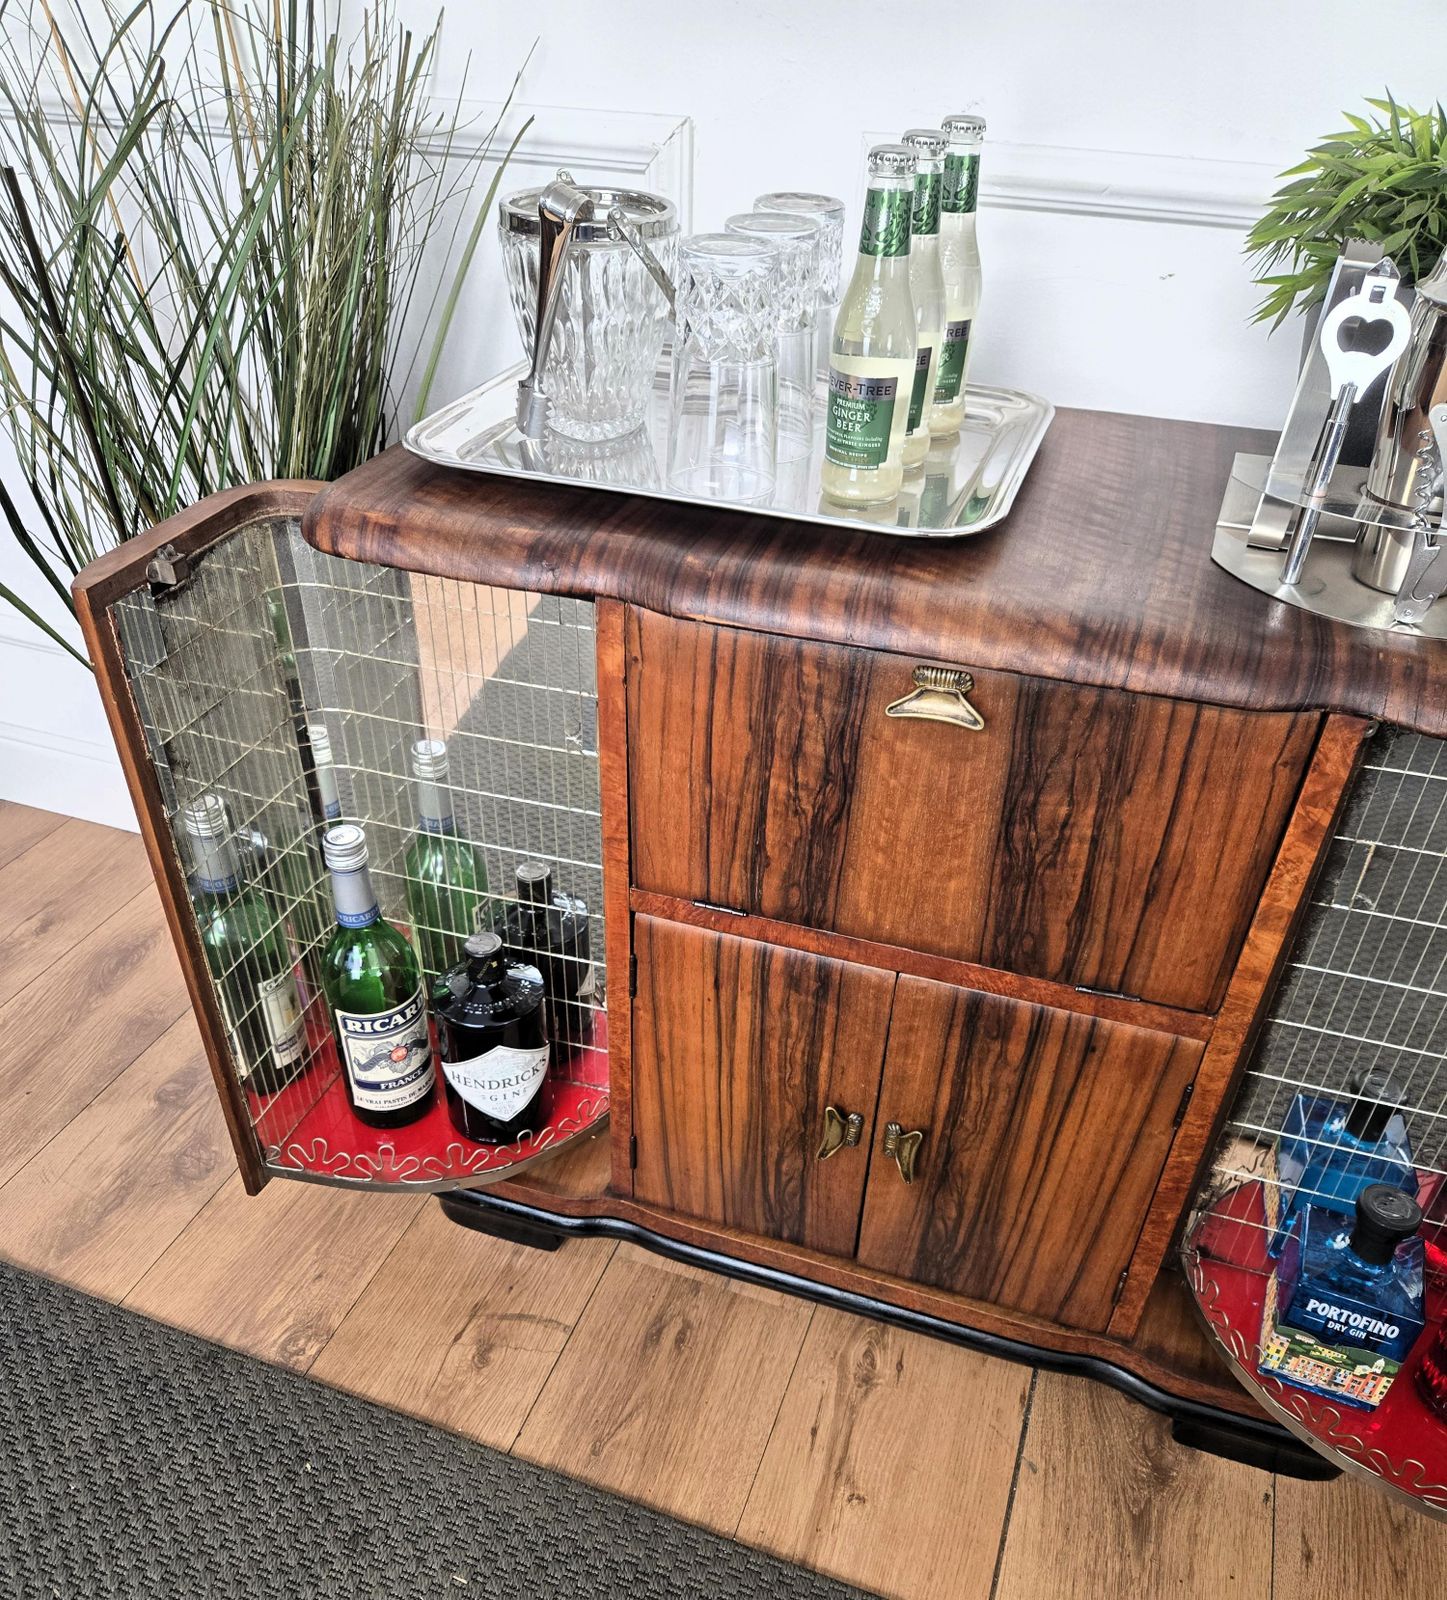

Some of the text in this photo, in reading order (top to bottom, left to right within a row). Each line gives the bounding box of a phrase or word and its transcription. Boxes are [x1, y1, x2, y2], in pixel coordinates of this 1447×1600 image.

[829, 376, 892, 396] EVER-TREE
[832, 405, 871, 422] GINGER
[836, 398, 866, 411] PREMIUM
[836, 418, 862, 432] BEER
[380, 1067, 423, 1090] FRANCE
[451, 1054, 547, 1090] HENDRICK'S
[489, 1090, 520, 1102] GIN
[1305, 1299, 1400, 1339] PORTOFINO
[1327, 1320, 1367, 1340] DRY GIN
